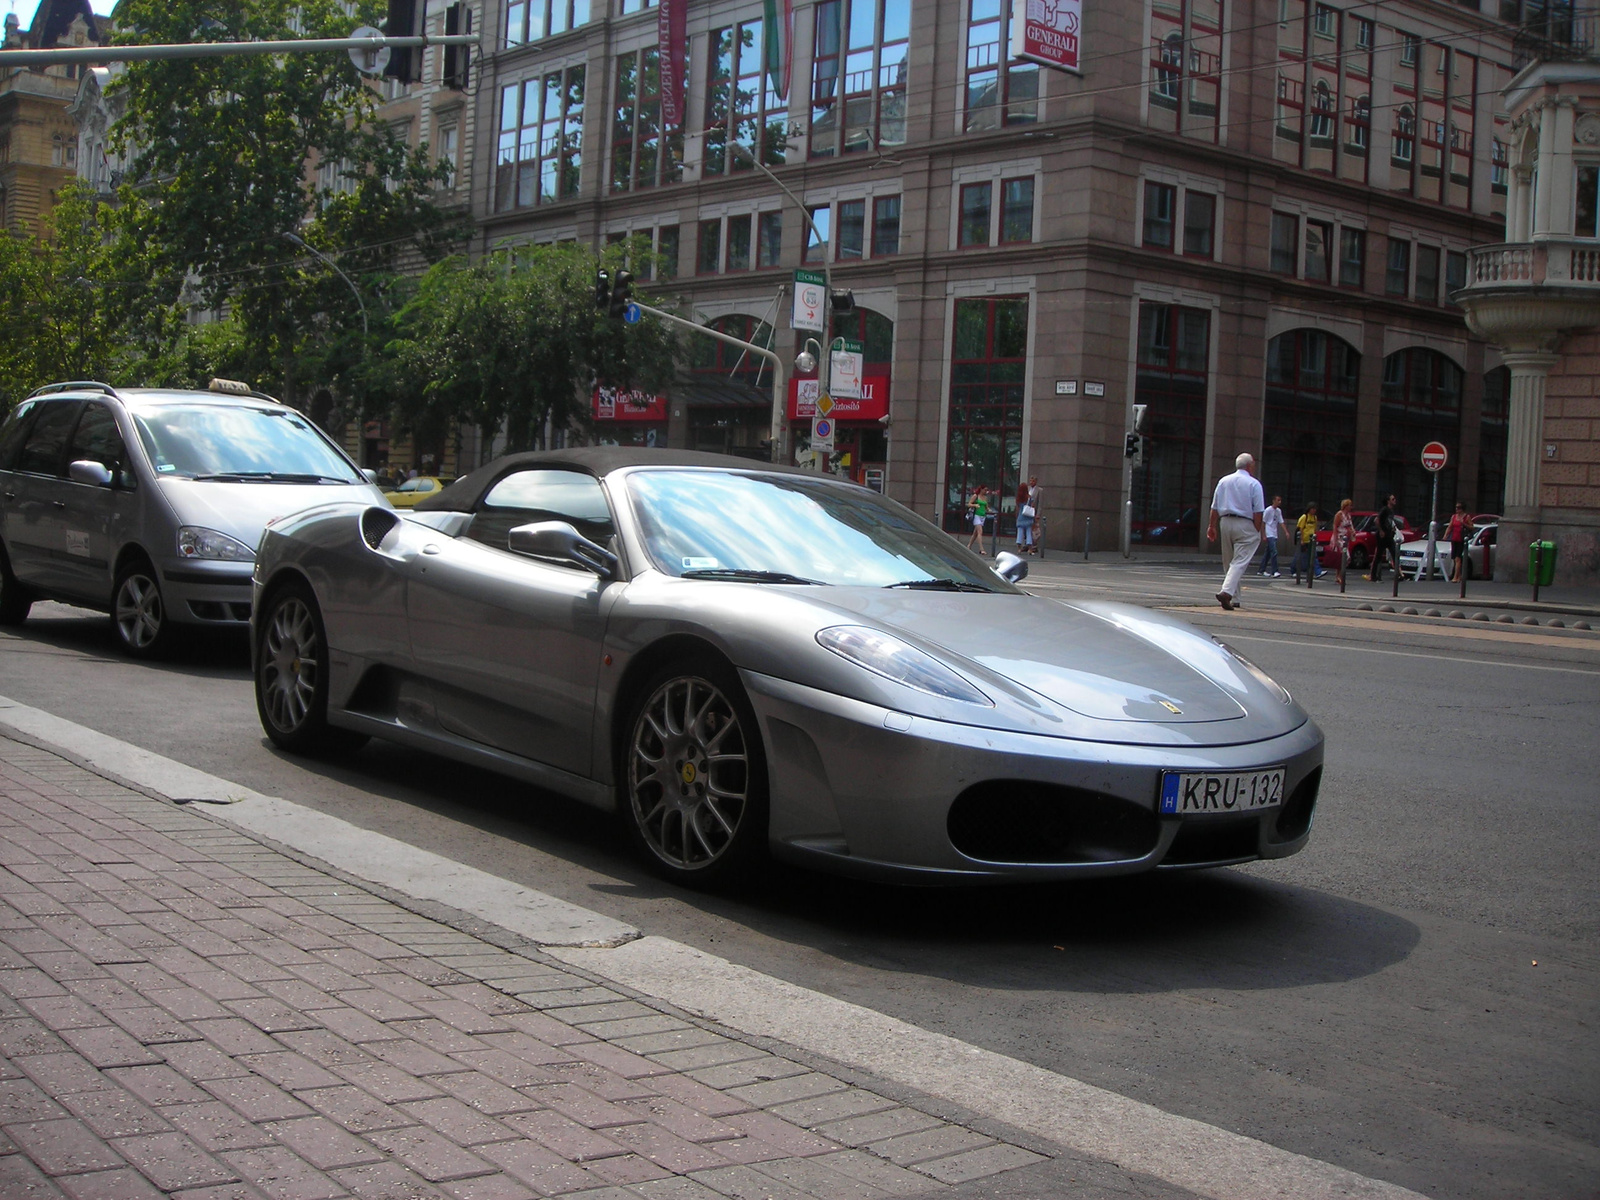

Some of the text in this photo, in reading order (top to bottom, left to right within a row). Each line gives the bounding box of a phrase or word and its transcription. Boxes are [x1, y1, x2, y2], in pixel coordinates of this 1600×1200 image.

[1027, 25, 1075, 52] GENERALI
[1040, 44, 1063, 58] GROUP
[217, 380, 248, 391] TAXI
[833, 400, 860, 411] iztosító
[1165, 772, 1281, 810] H KRU-132
